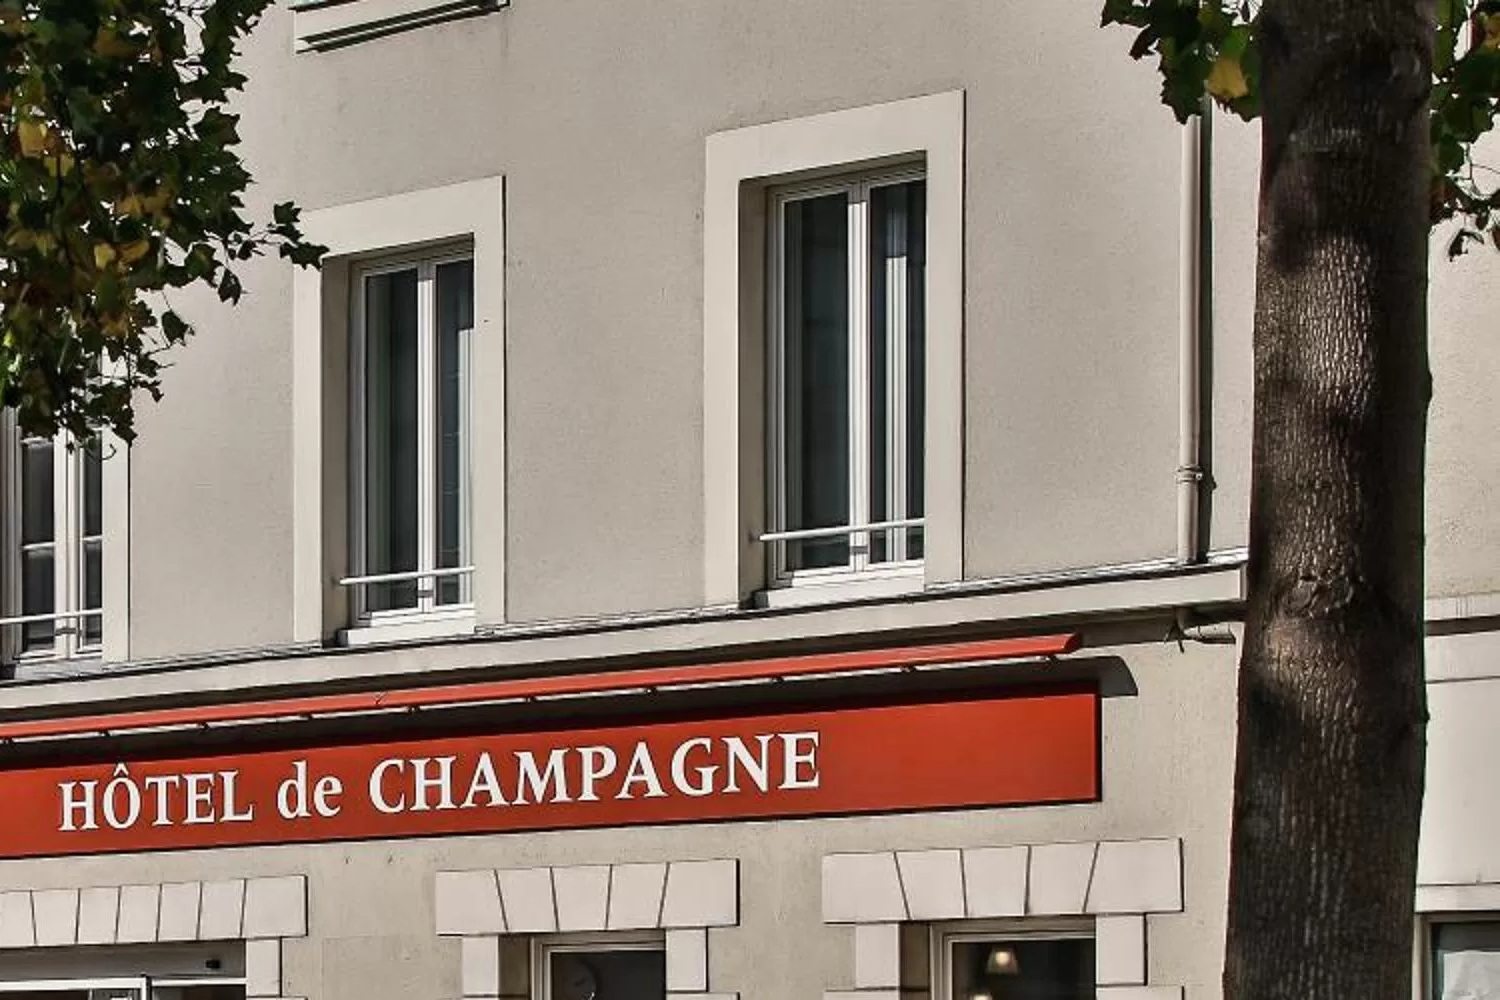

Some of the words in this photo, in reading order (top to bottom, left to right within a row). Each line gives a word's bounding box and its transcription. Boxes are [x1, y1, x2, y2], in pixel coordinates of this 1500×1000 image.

[57, 762, 253, 832] HÔTEL
[276, 759, 343, 820] de
[367, 731, 821, 814] CHAMPAGNE
